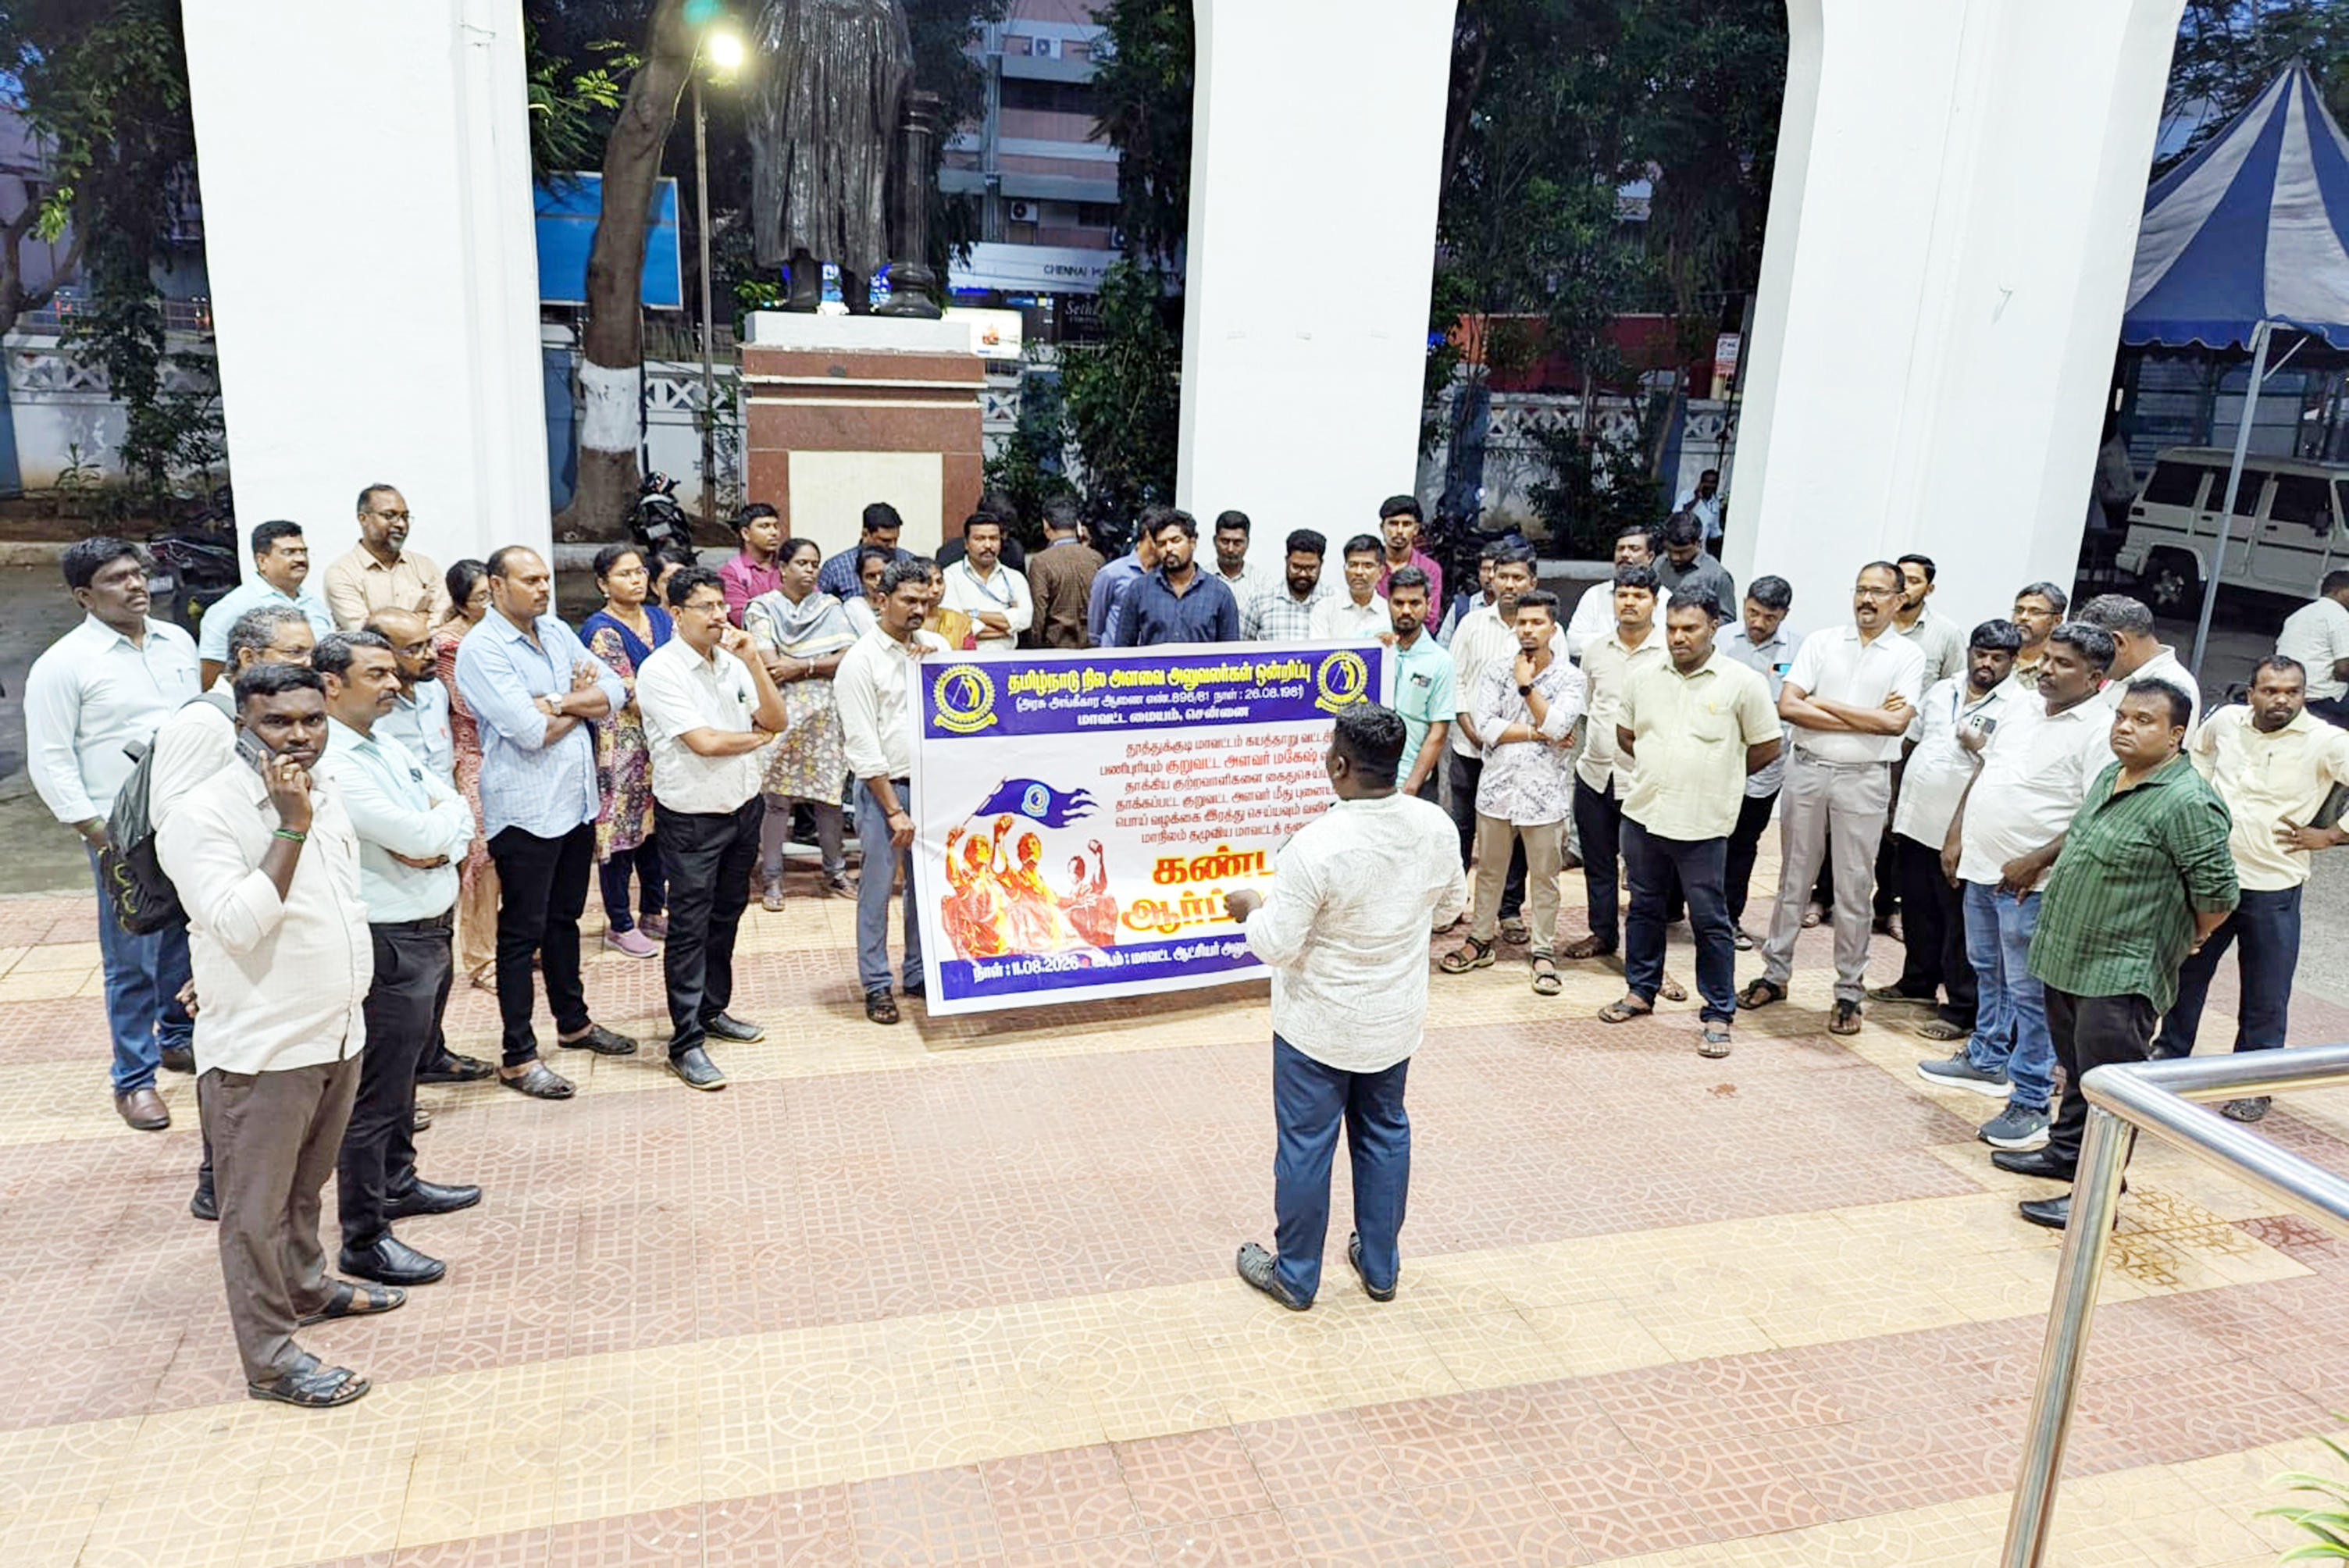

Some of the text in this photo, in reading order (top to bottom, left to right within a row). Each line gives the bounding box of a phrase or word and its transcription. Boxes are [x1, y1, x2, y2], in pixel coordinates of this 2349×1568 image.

[1043, 264, 1088, 276] CHENNAI
[1007, 659, 1311, 697] தமிழ்நாடு நில அளவை அலுவலர்கள் ஒன்றிப்பு
[1101, 694, 1143, 708] ஆணை
[1077, 712, 1128, 725] மாவட்ட
[1185, 706, 1249, 721] சென்னை
[1195, 735, 1243, 750] மாவட்டம்
[1165, 757, 1221, 775] குறுவட்ட
[1224, 751, 1270, 768] அளவர்
[1274, 748, 1317, 765] மகேஷ்
[1125, 777, 1170, 795] தாக்கிய
[1115, 795, 1180, 812] தாக்கப்பட்ட
[1183, 792, 1228, 809] குறுவட்ட
[1232, 787, 1271, 802] அளவர்
[1273, 786, 1293, 803] மீது
[1115, 813, 1148, 827] பொய்
[1142, 829, 1187, 845] மாநிலம்
[1153, 845, 1275, 885] கண்ட
[1131, 949, 1172, 964] மாவட்ட
